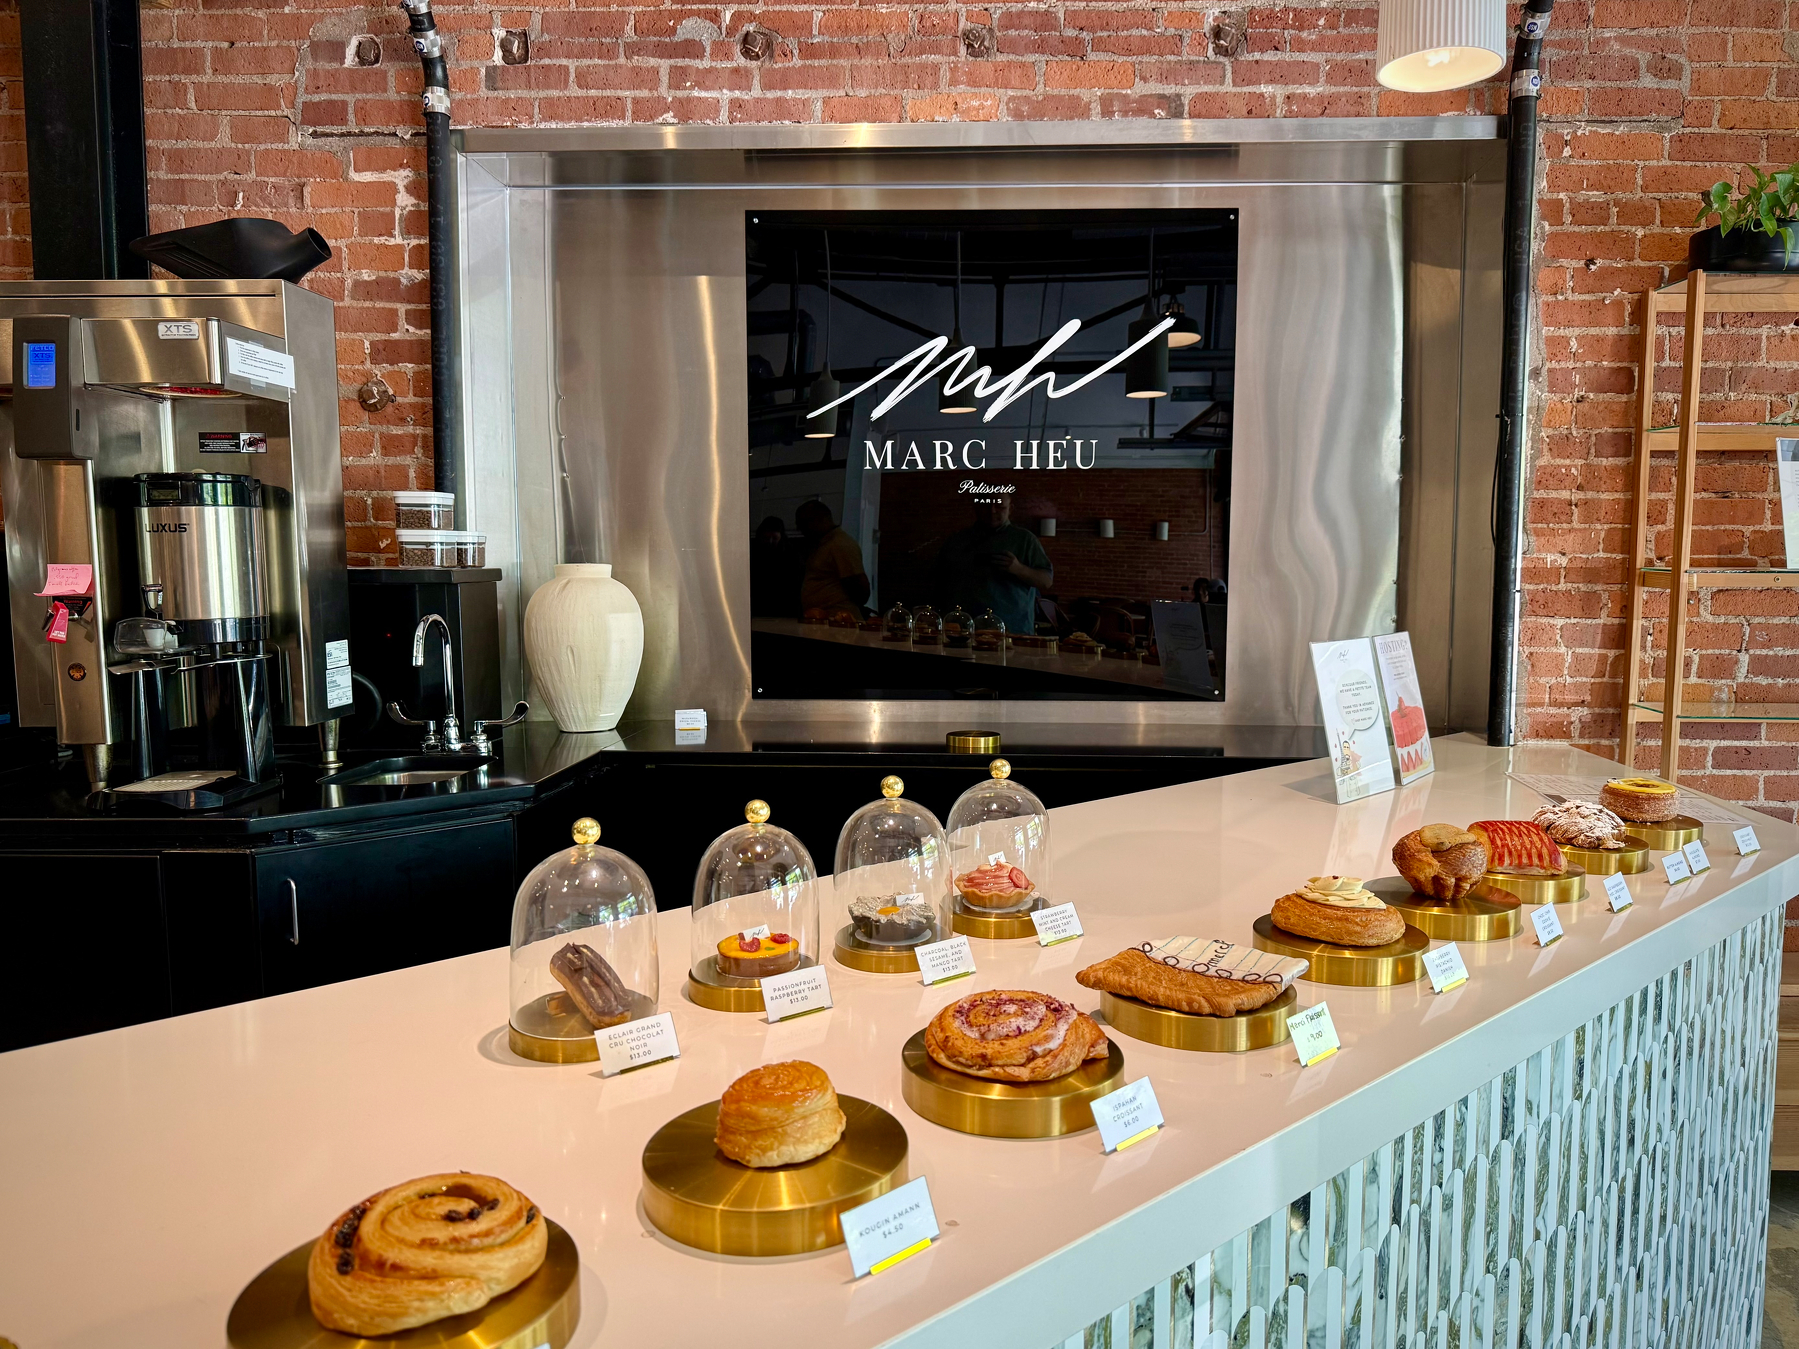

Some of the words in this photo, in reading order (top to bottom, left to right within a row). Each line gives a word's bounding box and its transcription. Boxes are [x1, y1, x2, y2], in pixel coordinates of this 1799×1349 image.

[164, 324, 193, 333] XTS
[863, 439, 986, 470] MARC
[145, 523, 187, 533] LUXUS
[1379, 639, 1408, 654] HOSTING?
[1040, 910, 1068, 920] STRAWBERRY
[1059, 914, 1074, 922] CREAM
[1044, 924, 1062, 932] CHEESE
[920, 948, 950, 958] CHARCOAL,
[950, 942, 967, 950] BLACK
[929, 954, 951, 963] SESAME,
[951, 949, 963, 957] AND
[931, 960, 950, 968] MANGO
[770, 989, 806, 1002] RASPBERRY
[807, 984, 822, 992] TART
[772, 979, 816, 993] PASSIONFRUIT
[789, 996, 809, 1004] $13.00
[1289, 1017, 1306, 1031] Merci
[608, 1030, 634, 1041] ECLAIR
[636, 1022, 662, 1033] GRAND
[609, 1041, 624, 1049] CRU
[625, 1030, 665, 1044] CHOCOLAT
[629, 1043, 648, 1051] NOIR
[629, 1050, 652, 1060] $13.00
[1112, 1096, 1137, 1112] ISPAHAN
[1112, 1104, 1144, 1122] CROISSANT
[1123, 1116, 1140, 1128] $6.00
[859, 1218, 891, 1237] KOUGIN
[892, 1203, 921, 1221] AMANN
[882, 1223, 905, 1239] $4.50
